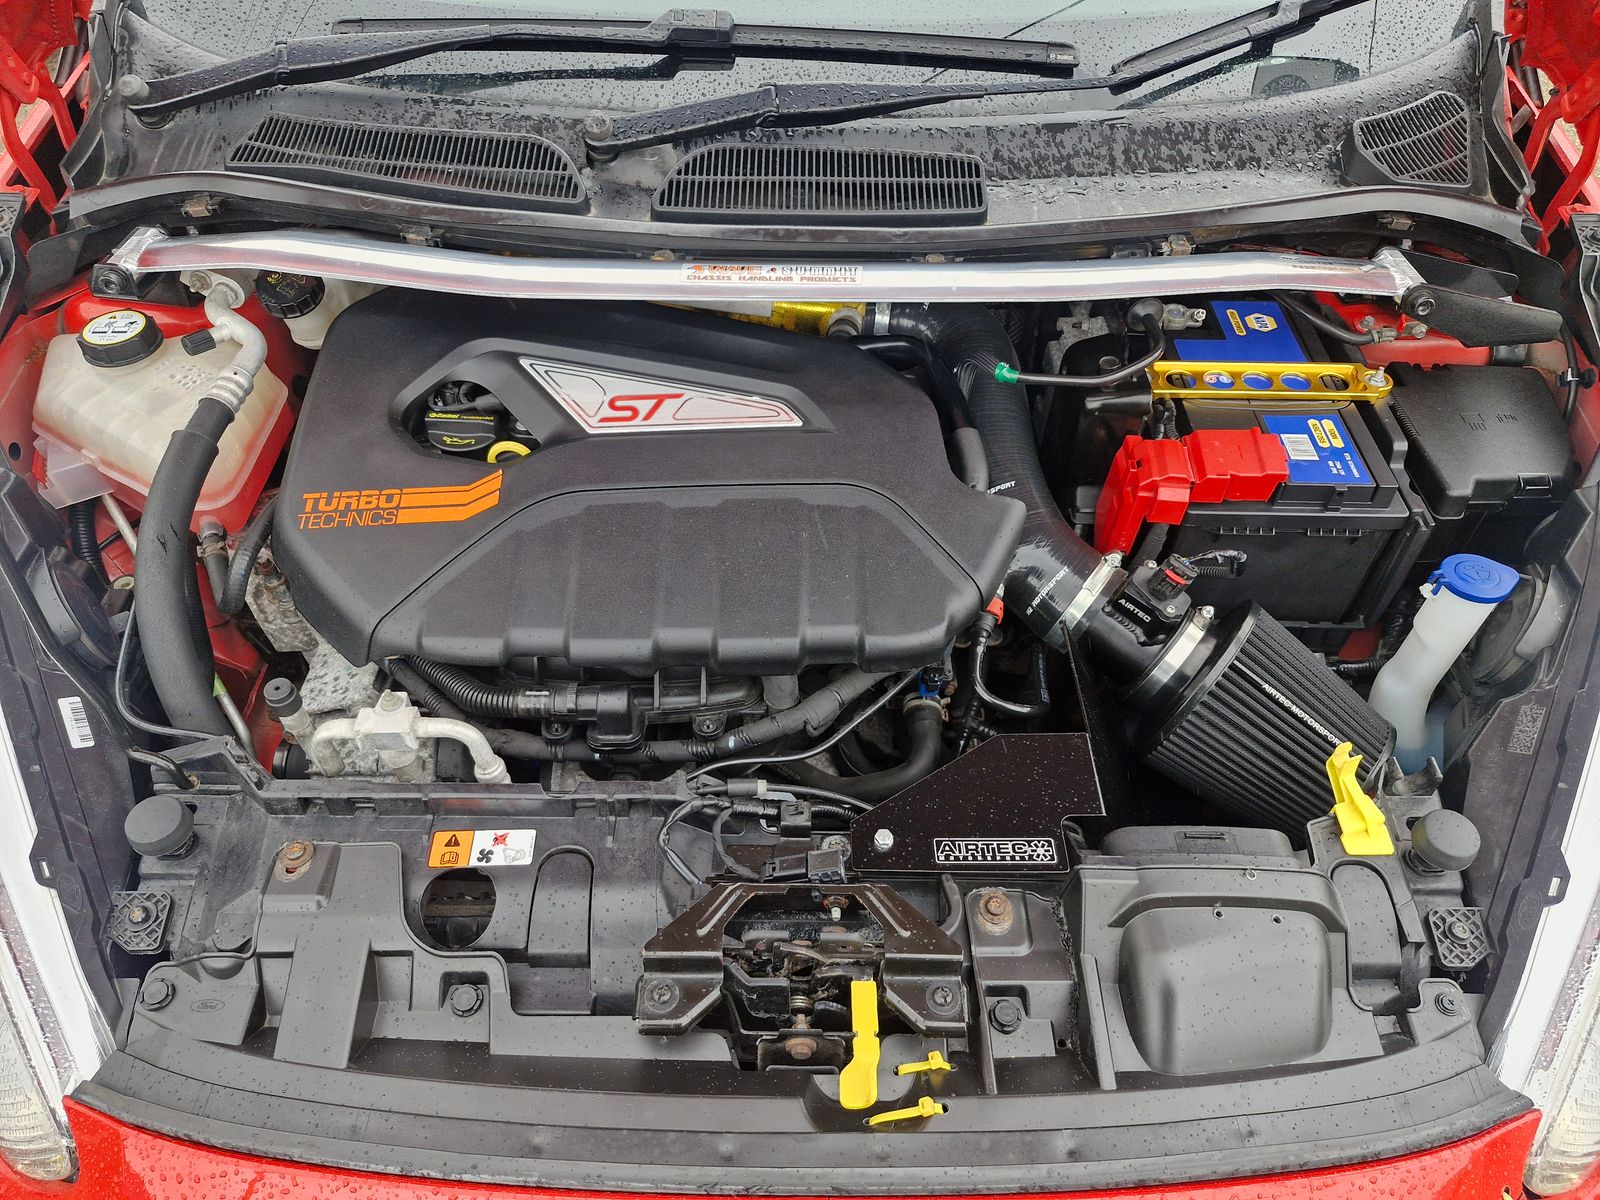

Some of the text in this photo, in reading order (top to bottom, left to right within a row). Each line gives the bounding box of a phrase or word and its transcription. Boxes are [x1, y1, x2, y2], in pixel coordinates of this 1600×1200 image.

[782, 266, 858, 276] SUMMIT
[598, 393, 685, 423] ST
[987, 481, 1015, 494] SPORT
[302, 489, 400, 513] TURBO
[298, 509, 397, 529] TECHNICS
[1032, 565, 1069, 607] MOTORSPORT
[1118, 599, 1151, 622] AIRTEC
[1291, 705, 1343, 746] MOTORSPOR
[937, 841, 1029, 856] AIRTEC
